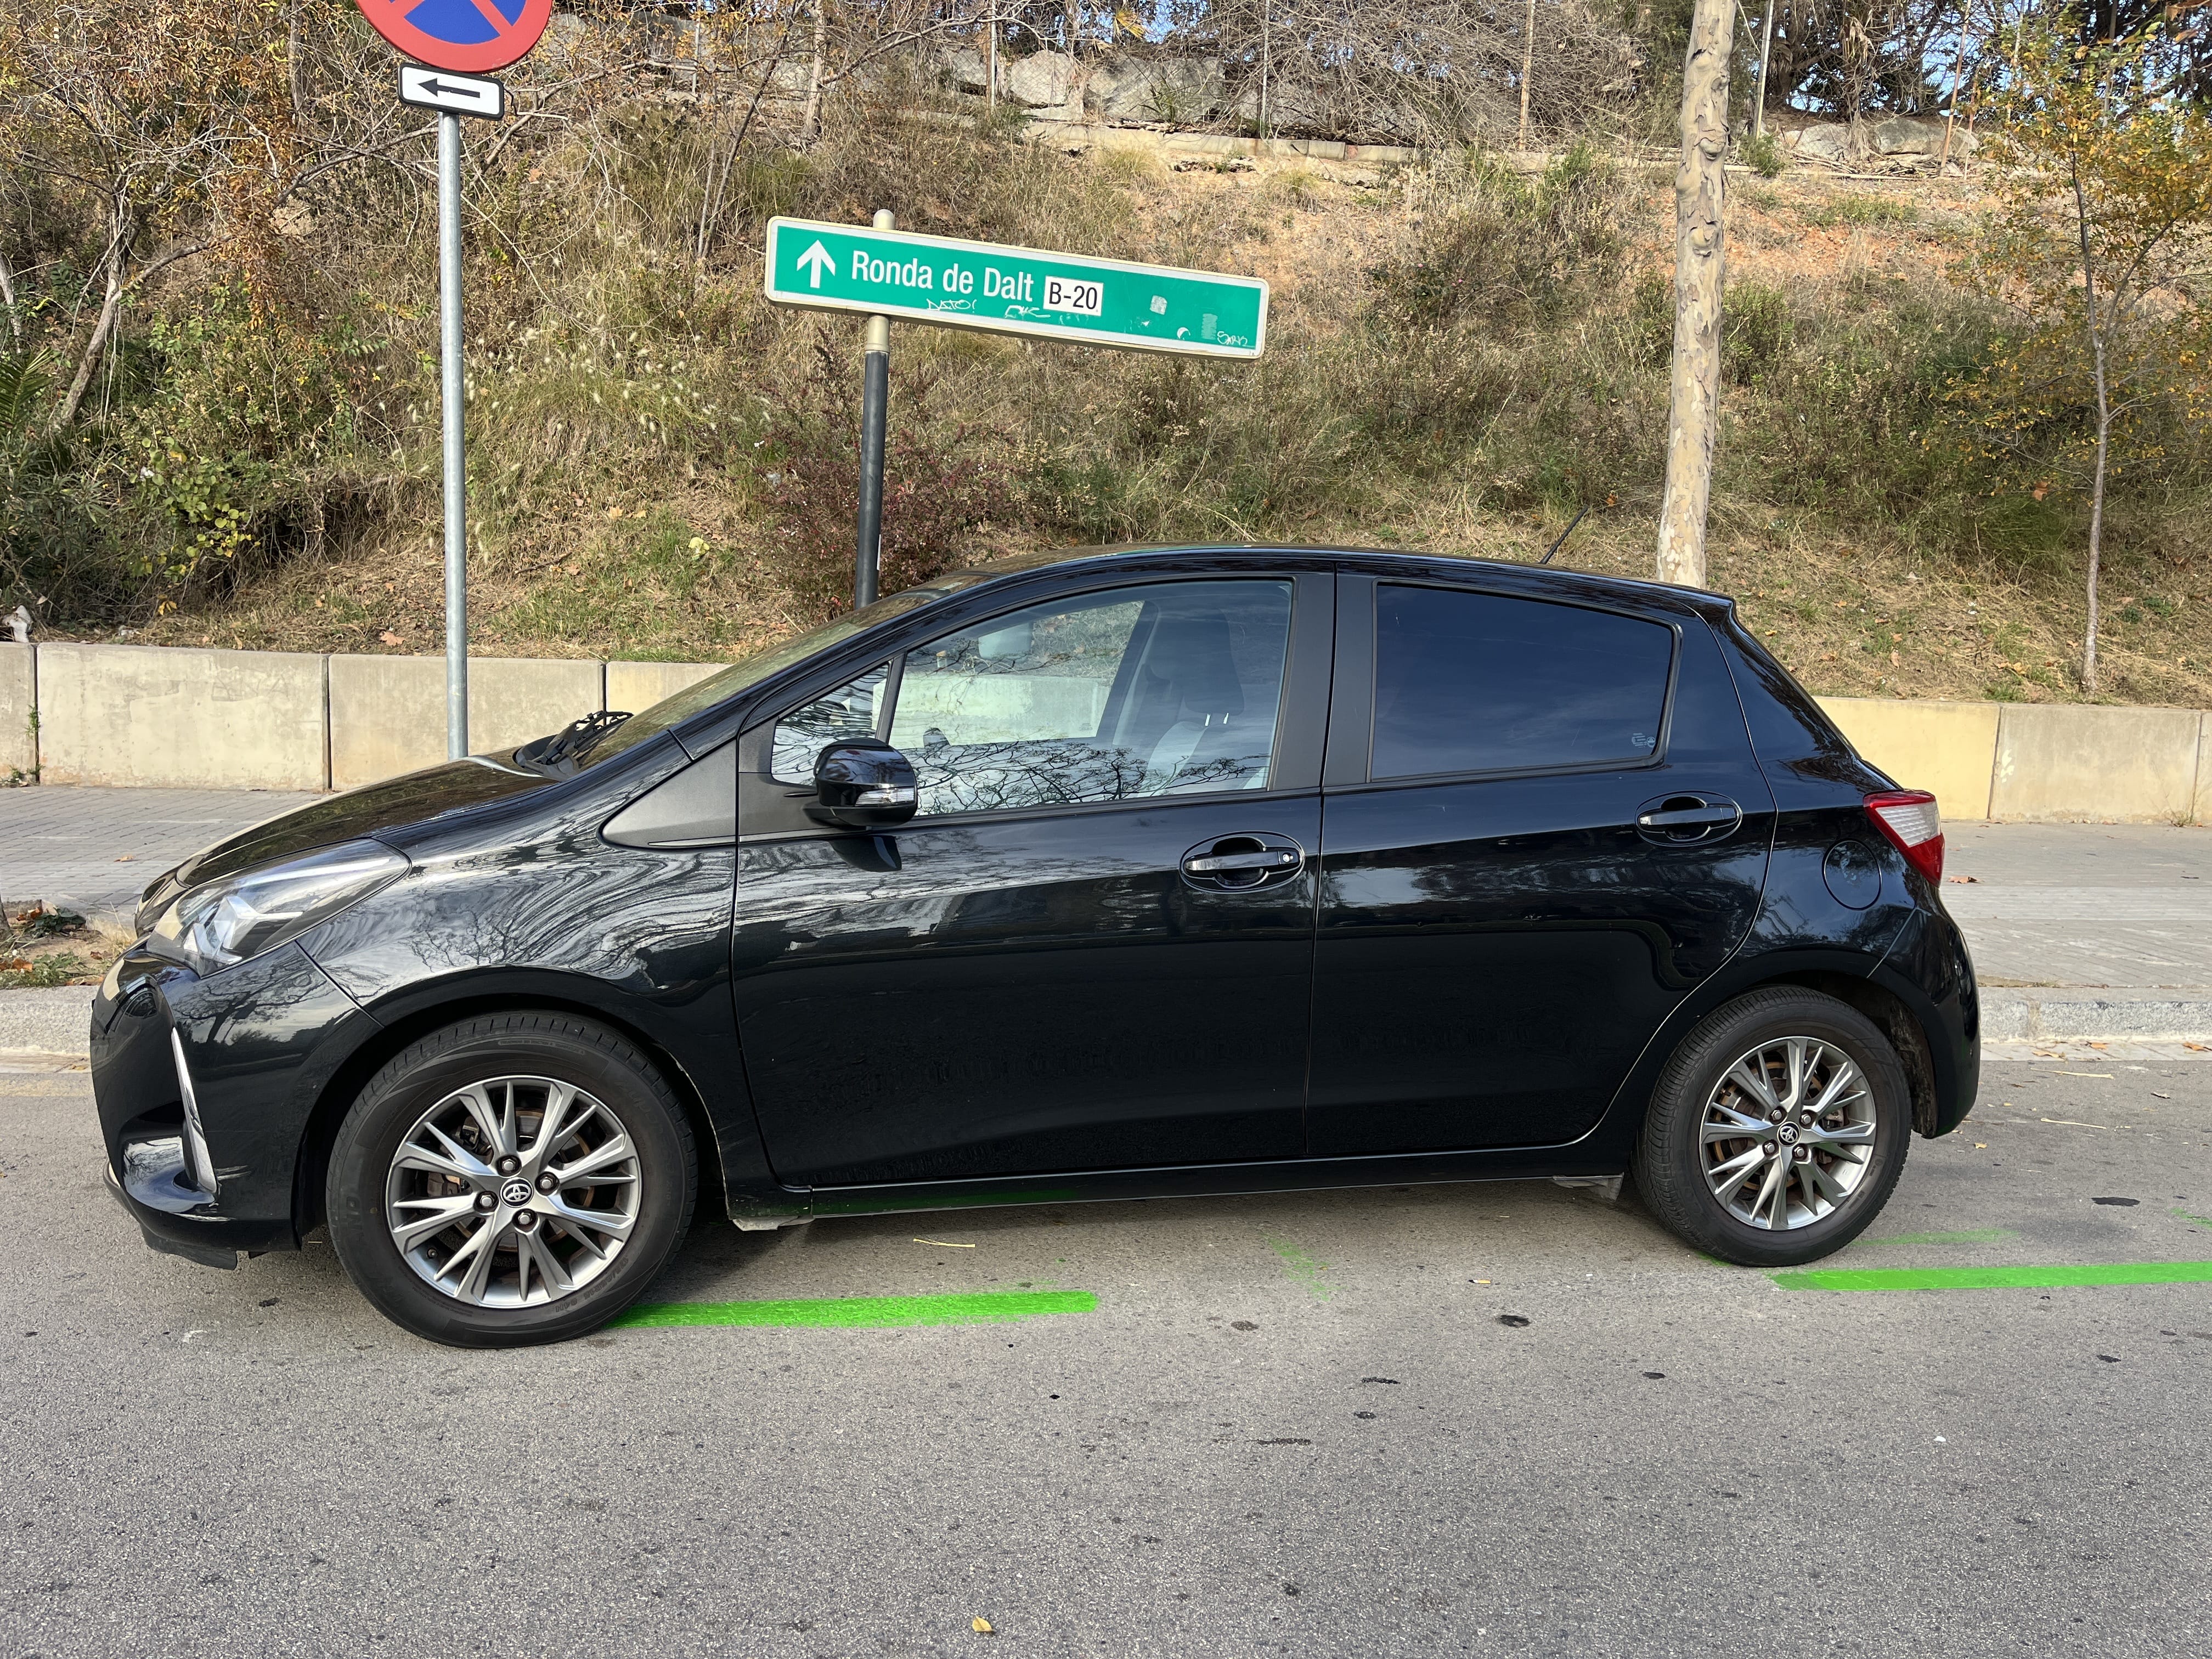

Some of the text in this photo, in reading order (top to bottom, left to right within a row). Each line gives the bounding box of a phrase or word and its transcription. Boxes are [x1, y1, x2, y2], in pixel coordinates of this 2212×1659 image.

[851, 250, 1098, 309] Ronda de Dalt B-20
